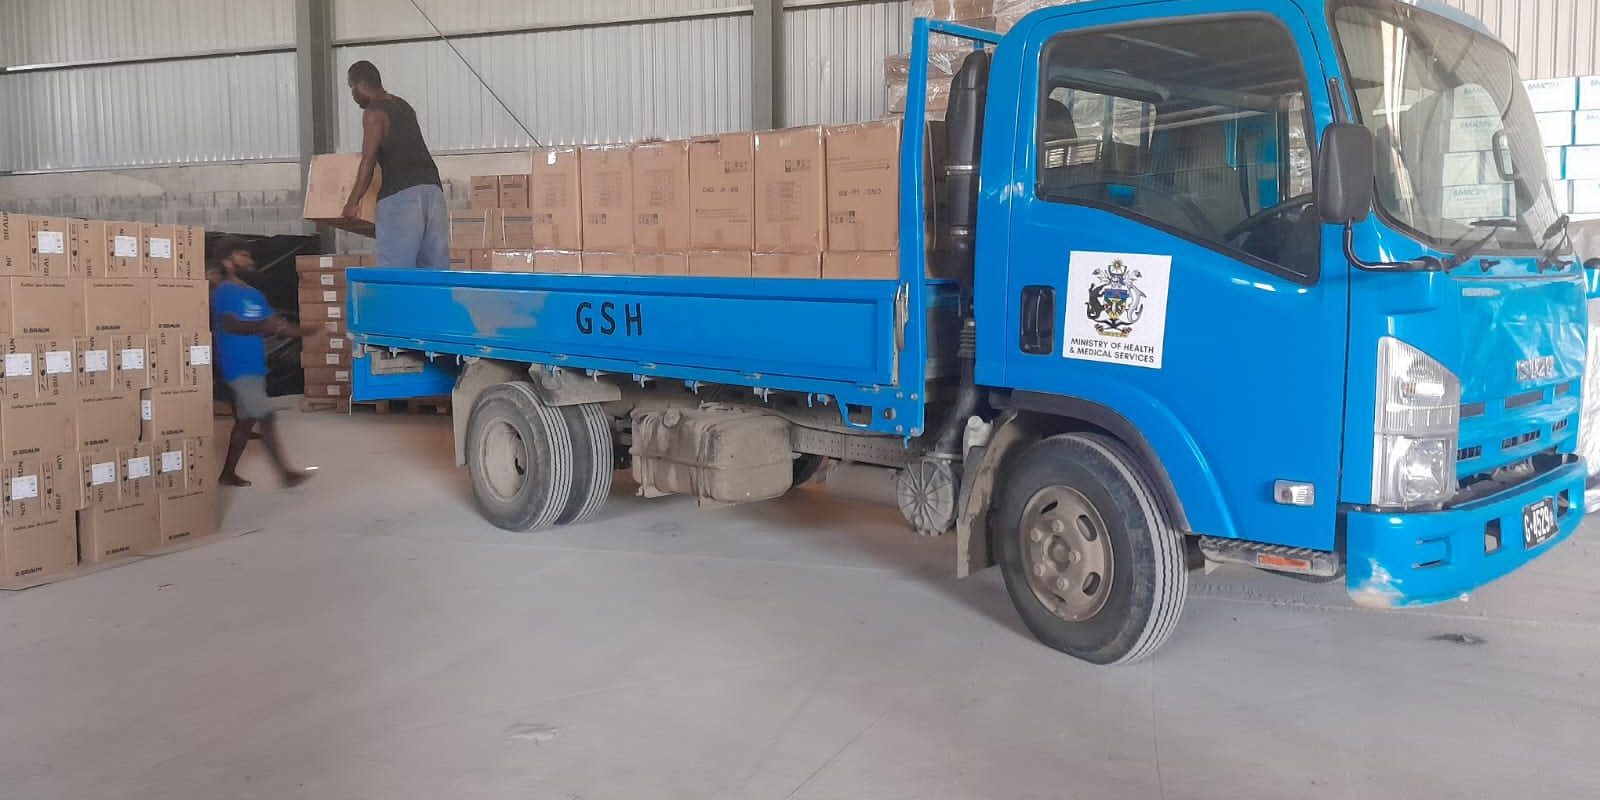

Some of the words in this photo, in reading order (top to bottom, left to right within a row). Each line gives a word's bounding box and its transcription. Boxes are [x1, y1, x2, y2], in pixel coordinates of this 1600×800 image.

[576, 301, 642, 336] GSH
[1070, 337, 1108, 349] MINISTRY
[1110, 342, 1121, 350] OF
[1123, 343, 1154, 354] HEALTH
[1069, 346, 1075, 354] &
[1077, 347, 1113, 358] MEDICAL
[1114, 351, 1154, 364] SERVICES
